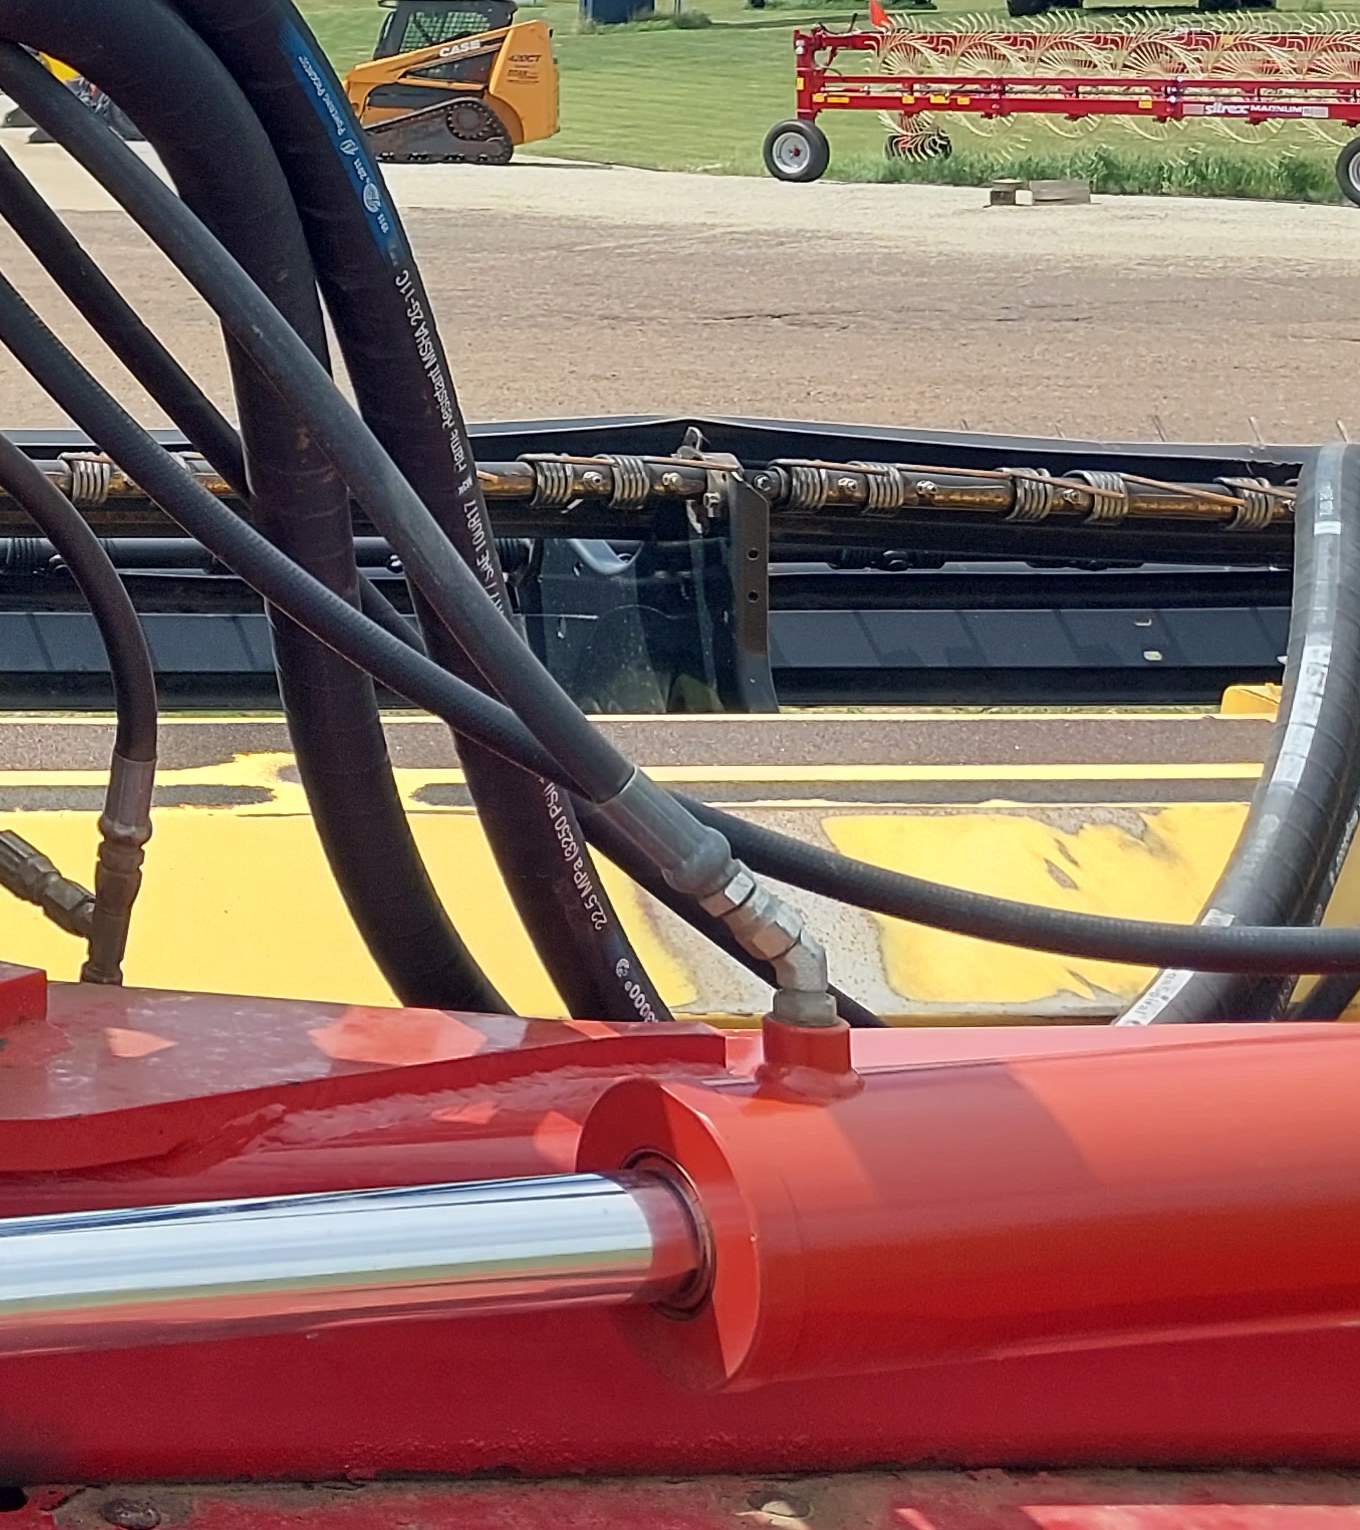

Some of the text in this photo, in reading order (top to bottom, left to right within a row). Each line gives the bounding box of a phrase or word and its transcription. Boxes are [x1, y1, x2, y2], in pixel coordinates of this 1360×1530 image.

[439, 39, 481, 57] CASE
[413, 321, 438, 371] MSHA
[426, 362, 456, 430] Resistant
[553, 814, 580, 862] (3250
[572, 856, 594, 900] MPa
